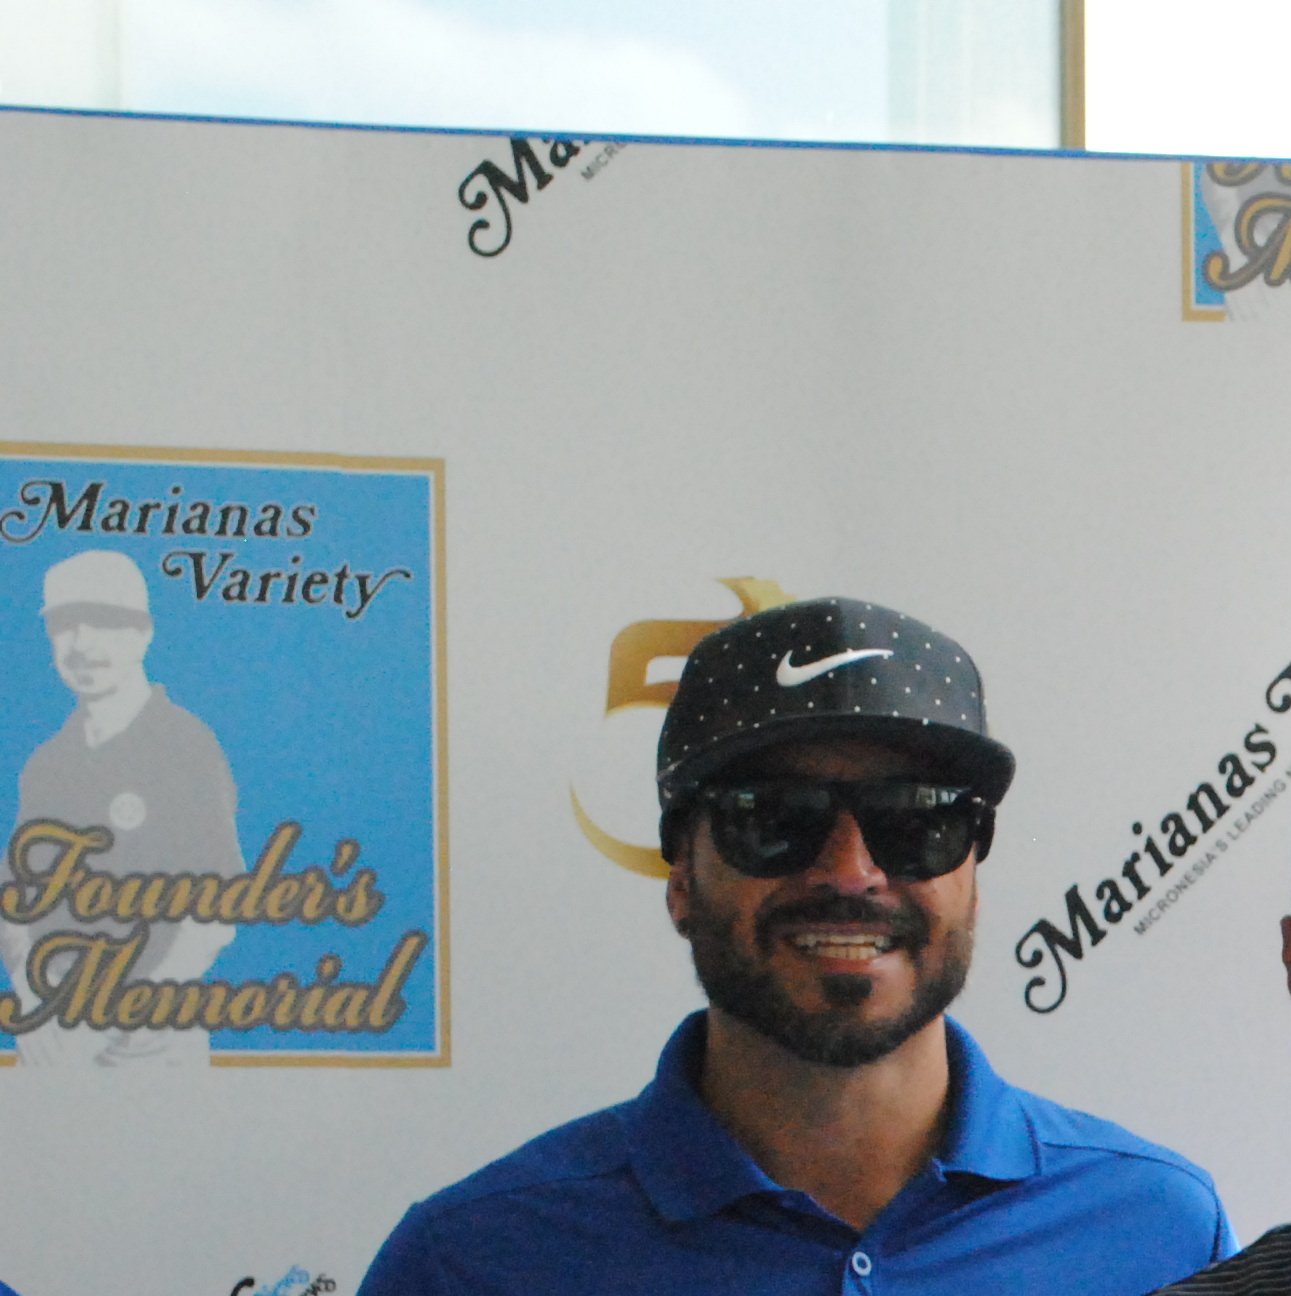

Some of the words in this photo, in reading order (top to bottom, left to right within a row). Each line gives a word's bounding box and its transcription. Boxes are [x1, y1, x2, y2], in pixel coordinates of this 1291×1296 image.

[0, 478, 317, 544] Marianas
[162, 550, 411, 619] Variety
[0, 818, 386, 927] Founder's
[1015, 721, 1277, 1013] Marianas
[1134, 840, 1229, 936] MICRONESIA'S
[1227, 778, 1288, 841] LEADING
[0, 920, 428, 1034] Memorial
